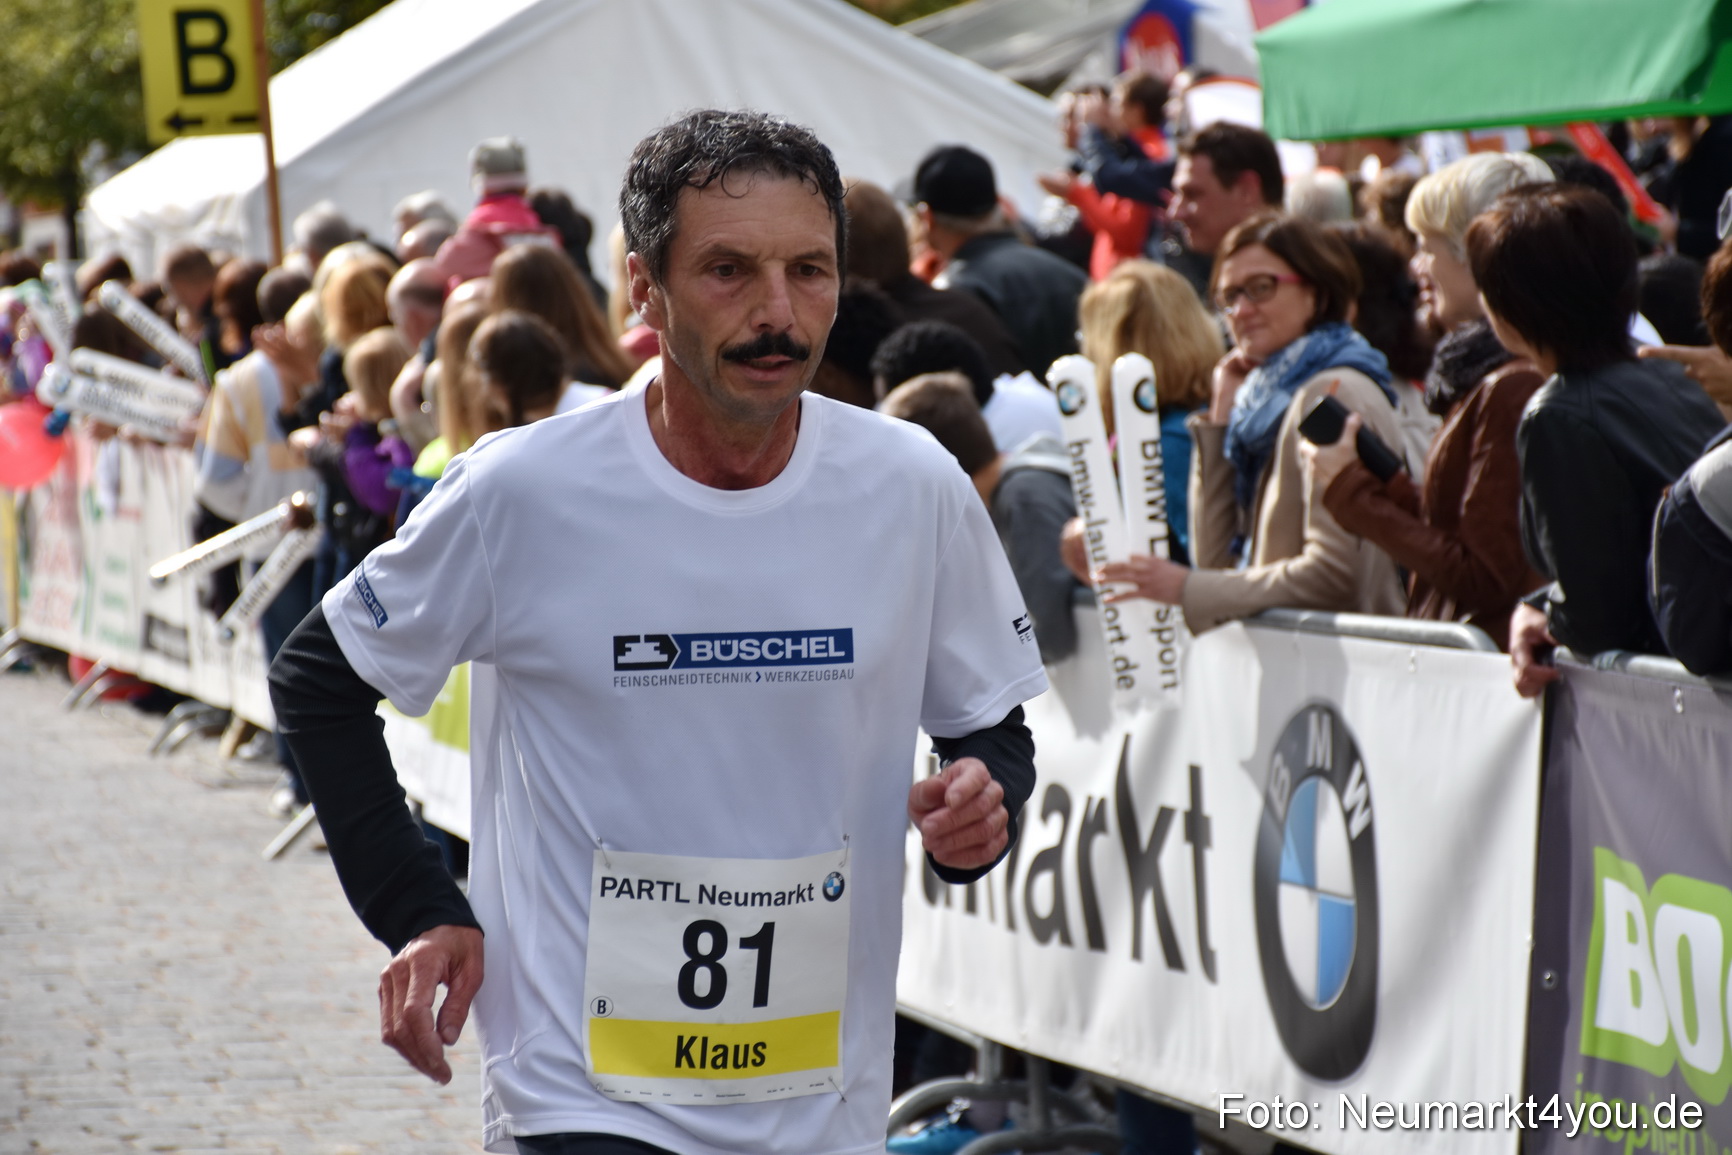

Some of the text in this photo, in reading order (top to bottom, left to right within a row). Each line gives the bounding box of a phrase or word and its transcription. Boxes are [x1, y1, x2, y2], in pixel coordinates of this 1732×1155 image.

[174, 9, 237, 96] B
[1141, 440, 1182, 691] BMW Lsport
[613, 668, 855, 688] FEINSCHNEIDTECHNIK WERKZEUGBAU
[690, 636, 846, 662] BÜSCHEL
[1268, 710, 1372, 841] BMW
[600, 876, 815, 907] PARTL Neumarkt
[677, 919, 776, 1010] 81
[1594, 876, 1732, 1076] BO
[596, 999, 608, 1015] B
[674, 1034, 768, 1071] Klaus
